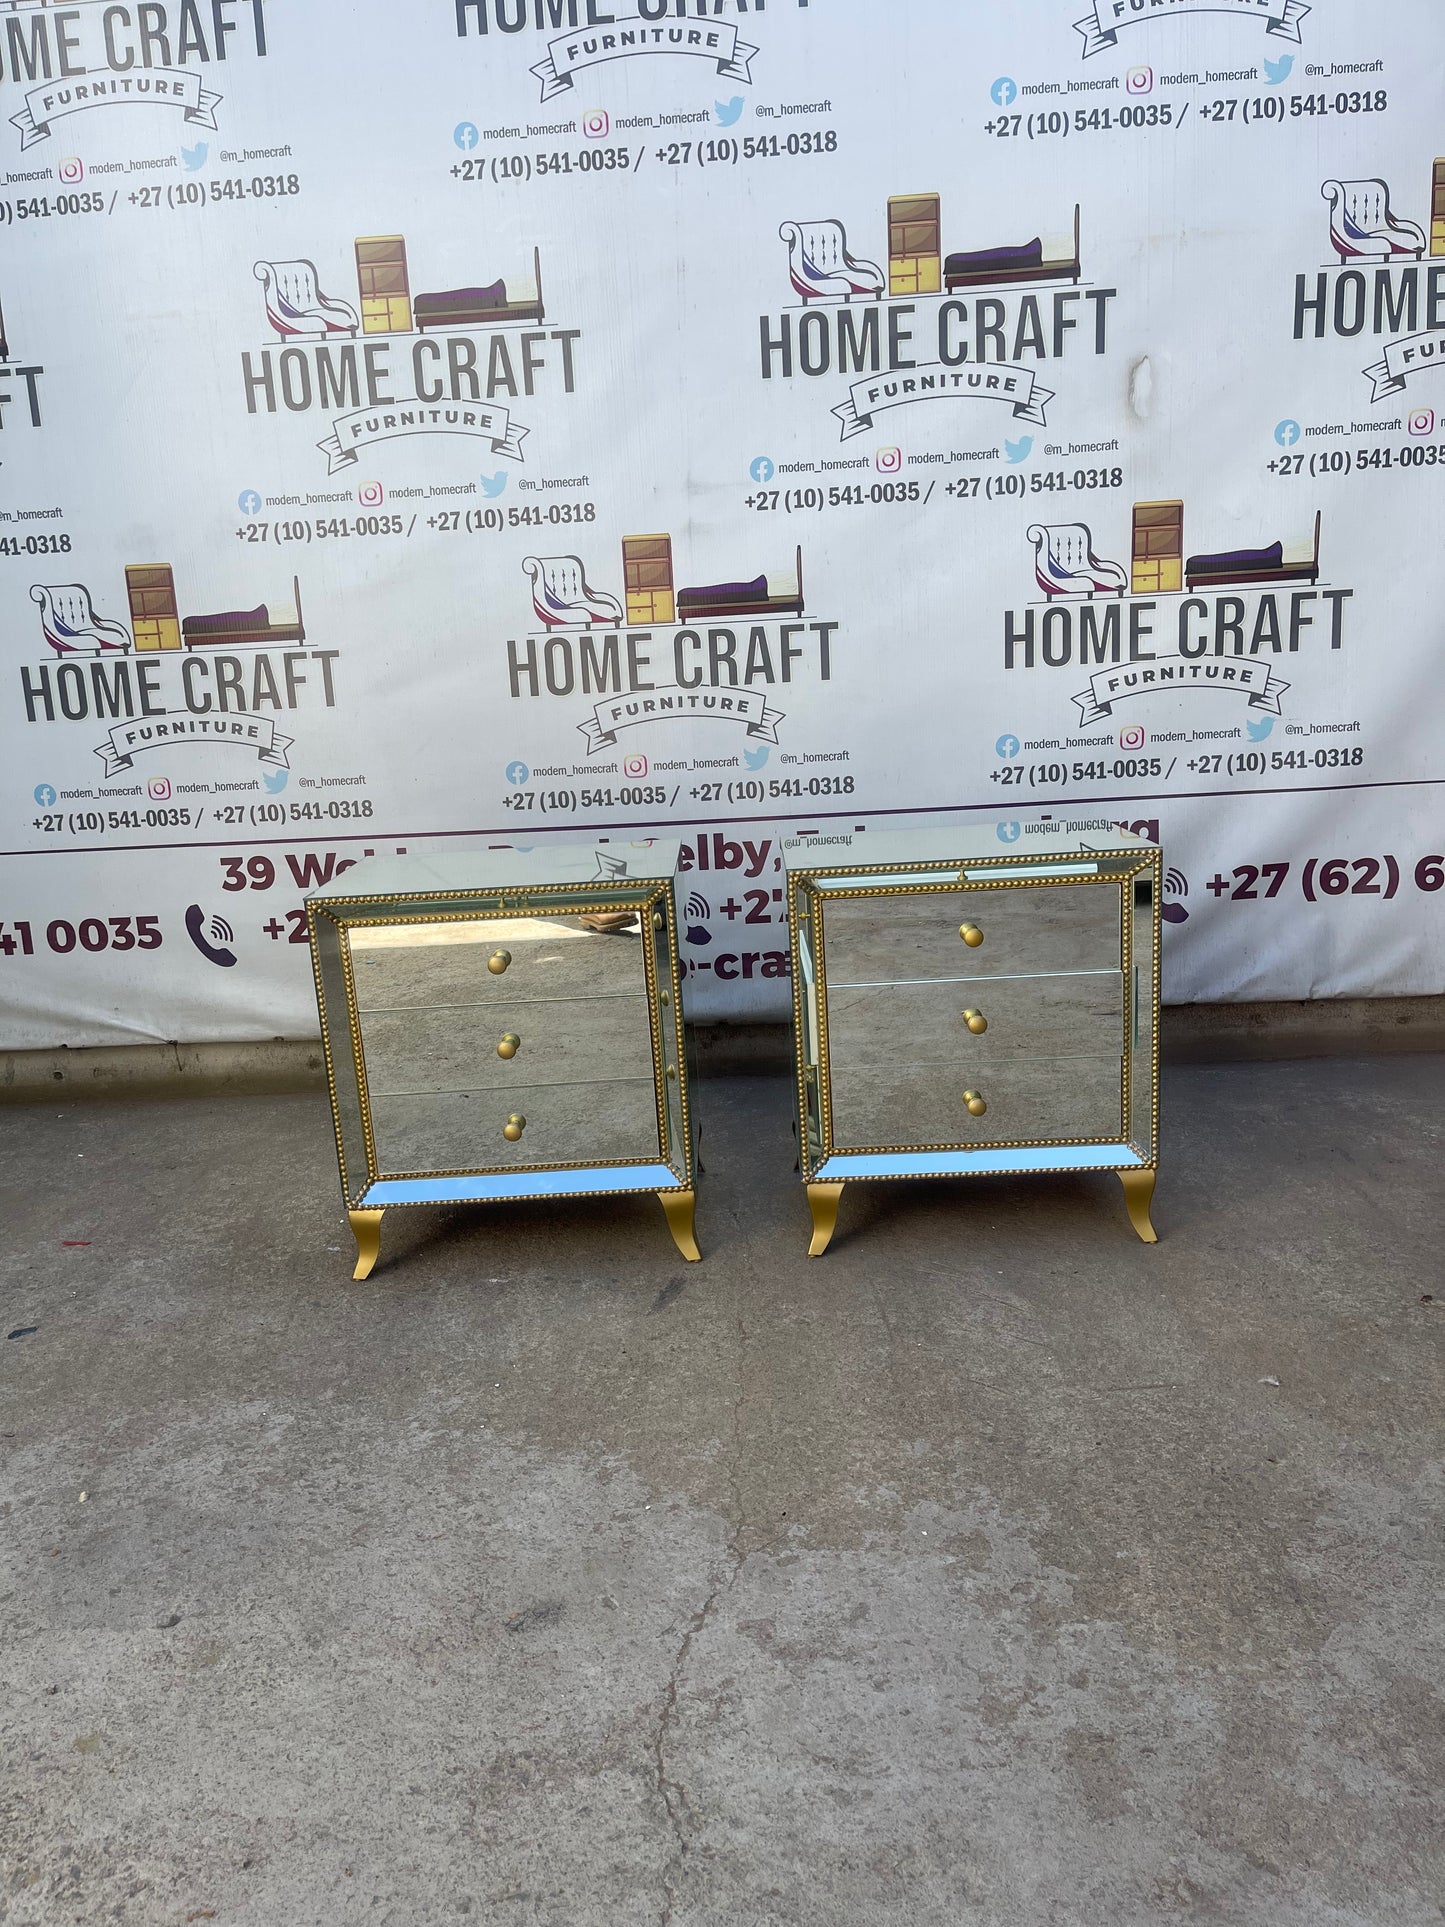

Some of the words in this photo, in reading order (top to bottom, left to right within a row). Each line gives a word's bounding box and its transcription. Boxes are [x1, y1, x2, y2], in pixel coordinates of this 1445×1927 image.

[0, 10, 86, 84] ME
[103, 0, 267, 72] CRAFT
[567, 29, 719, 61] FURNITURE
[1305, 59, 1383, 77] @m_homecraft
[42, 79, 184, 111] FURNITURE
[756, 100, 831, 118] @m_homecraft
[985, 115, 1022, 137] +27
[1028, 111, 1069, 139] (10)
[1074, 104, 1172, 131] 541-0035
[1176, 103, 1189, 129] /
[1200, 99, 1237, 121] +27
[1243, 97, 1284, 124] (10)
[1290, 90, 1387, 116] 541-0318
[0, 167, 53, 186] _homecraft
[220, 145, 292, 163] @m_homecraft
[450, 159, 485, 181] +27
[491, 155, 531, 183] (10)
[536, 147, 629, 175] 541-0035
[634, 146, 645, 172] /
[656, 142, 692, 164] +27
[697, 139, 738, 167] (10)
[743, 131, 837, 158] 541-0318
[17, 192, 104, 219] 541-0035
[109, 190, 118, 215] /
[128, 186, 161, 207] +27
[168, 182, 206, 209] (10)
[211, 174, 299, 201] 541-0318
[1293, 266, 1445, 339] HOME
[760, 304, 916, 379] HOME
[939, 288, 1116, 365] CRAFT
[241, 343, 395, 413] HOME
[413, 330, 581, 401] CRAFT
[868, 374, 1017, 403] FURNITURE
[351, 410, 492, 438] FURNITURE
[1044, 439, 1118, 456] @m_homecraft
[1267, 454, 1304, 475] +27
[1310, 451, 1351, 477] (10)
[519, 475, 589, 491] @m_homecraft
[745, 491, 780, 511] +27
[785, 488, 824, 513] (10)
[829, 481, 919, 506] 541-0035
[923, 480, 935, 504] /
[945, 477, 981, 497] +27
[986, 475, 1025, 500] (10)
[1031, 467, 1122, 492] 541-0318
[236, 523, 268, 542] +27
[274, 520, 311, 545] (10)
[316, 515, 403, 538] 541-0035
[407, 514, 417, 537] /
[427, 511, 460, 531] +27
[466, 509, 504, 533] (10)
[509, 503, 595, 526] 541-0318
[1005, 602, 1156, 669] HOME
[1179, 589, 1353, 659] CRAFT
[507, 633, 655, 697] HOME
[674, 622, 838, 689] CRAFT
[20, 659, 166, 722] HOME
[182, 650, 339, 714] CRAFT
[1108, 666, 1253, 692] FURNITURE
[611, 696, 749, 721] FURNITURE
[125, 721, 258, 745] FURNITURE
[1285, 721, 1360, 736] @m_homecraft
[781, 750, 849, 765] @m_homecraft
[990, 766, 1024, 785] +27
[1029, 764, 1067, 787] (10)
[1072, 758, 1161, 780] 541-0035
[1165, 757, 1177, 779] /
[1187, 755, 1222, 773] +27
[1227, 753, 1266, 776] (10)
[1271, 747, 1363, 770] 541-0318
[299, 775, 366, 789] @m_homecraft
[503, 792, 535, 810] +27
[540, 791, 576, 813] (10)
[581, 786, 666, 807] 541-0035
[670, 785, 680, 807] /
[690, 783, 722, 801] +27
[728, 781, 764, 804] (10)
[769, 776, 854, 798] 541-0318
[33, 814, 63, 832] +27
[69, 812, 104, 834] (10)
[108, 808, 190, 829] 541-0035
[195, 808, 204, 829] /
[213, 806, 245, 823] +27
[250, 804, 286, 826] (10)
[290, 800, 373, 820] 541-0318
[679, 832, 782, 878] elby,
[220, 856, 275, 891] 39
[1206, 862, 1290, 900] +27
[1302, 855, 1399, 902] (62)
[47, 916, 162, 953] 0035
[263, 910, 310, 944] +2
